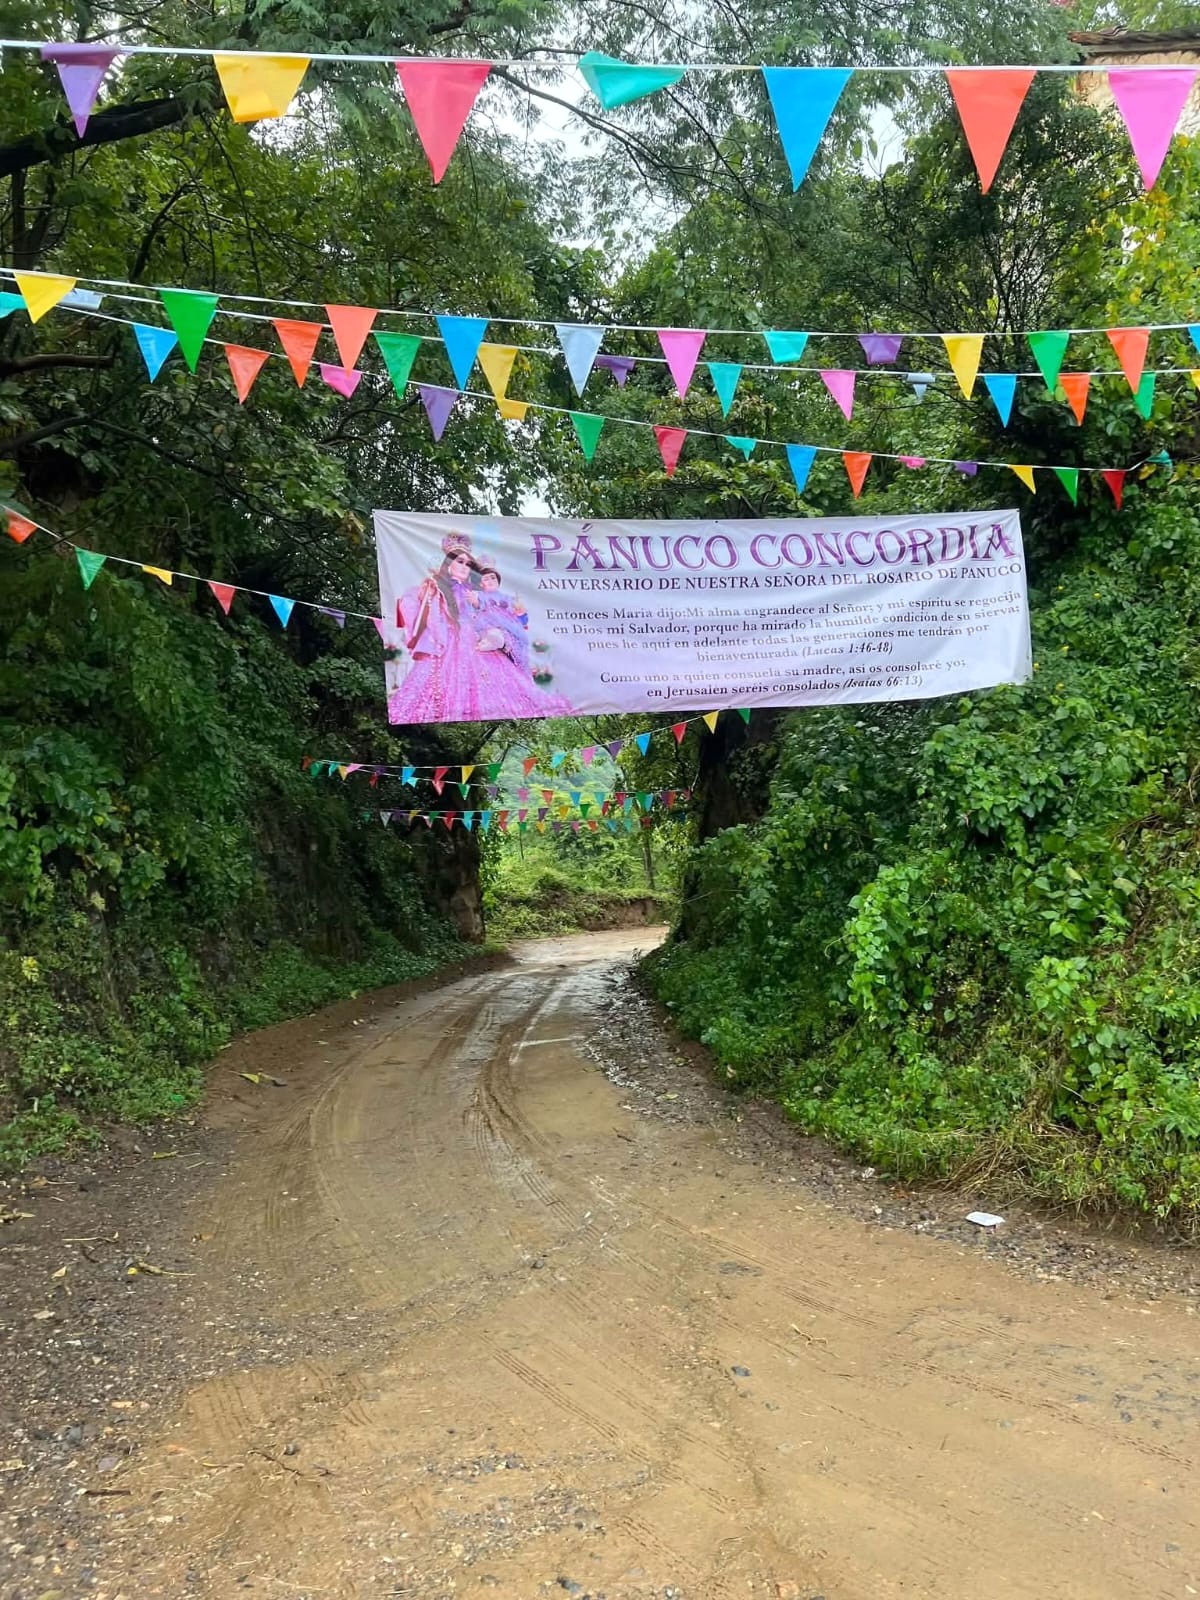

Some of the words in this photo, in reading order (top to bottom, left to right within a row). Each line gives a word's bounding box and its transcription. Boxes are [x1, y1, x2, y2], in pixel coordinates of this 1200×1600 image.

[530, 523, 738, 571] PÁNUCO
[749, 523, 1017, 569] CONCORDIA
[538, 577, 653, 591] ANIVERSARIO
[659, 577, 680, 590] DE
[685, 576, 760, 590] NUESTRA
[764, 572, 826, 588] SEÑORA
[832, 573, 862, 586] DEL
[867, 570, 933, 584] ROSARIO
[938, 567, 958, 580] DE
[546, 608, 609, 620] Entonces
[708, 606, 740, 617] alma
[744, 604, 815, 618] engrandece
[818, 603, 829, 614] al
[877, 602, 885, 614] y
[888, 601, 905, 610] mi
[955, 599, 966, 607] se
[969, 591, 1021, 607] regocija
[553, 625, 568, 634] en
[573, 624, 602, 634] Dios
[607, 623, 625, 634] mi
[628, 622, 690, 635] Salvador,
[694, 622, 739, 636] porque
[743, 620, 757, 632] ha
[761, 619, 806, 631] mirado
[810, 618, 821, 629] la
[825, 616, 879, 628] humilde
[941, 611, 954, 622] de
[957, 613, 970, 621] su
[588, 640, 619, 651] pues
[622, 639, 638, 649] he
[674, 641, 689, 649] en
[694, 637, 751, 648] adelante
[752, 635, 790, 646] todas
[791, 633, 810, 643] las
[813, 629, 894, 645] generaciones
[897, 629, 915, 638] me
[918, 626, 962, 637] tendrán
[967, 624, 989, 636] por
[697, 648, 799, 662] bienaventurada
[802, 645, 845, 659] (Lucas
[849, 641, 893, 655] 1:46-48)
[600, 672, 640, 683] Como
[645, 674, 669, 682] uno
[684, 670, 720, 684] quien
[724, 667, 780, 680] consuela
[785, 668, 800, 677] su
[803, 664, 845, 676] madre,
[869, 665, 882, 673] os
[647, 689, 662, 697] en
[772, 679, 840, 693] consolados
[886, 675, 924, 687] 66:13)
